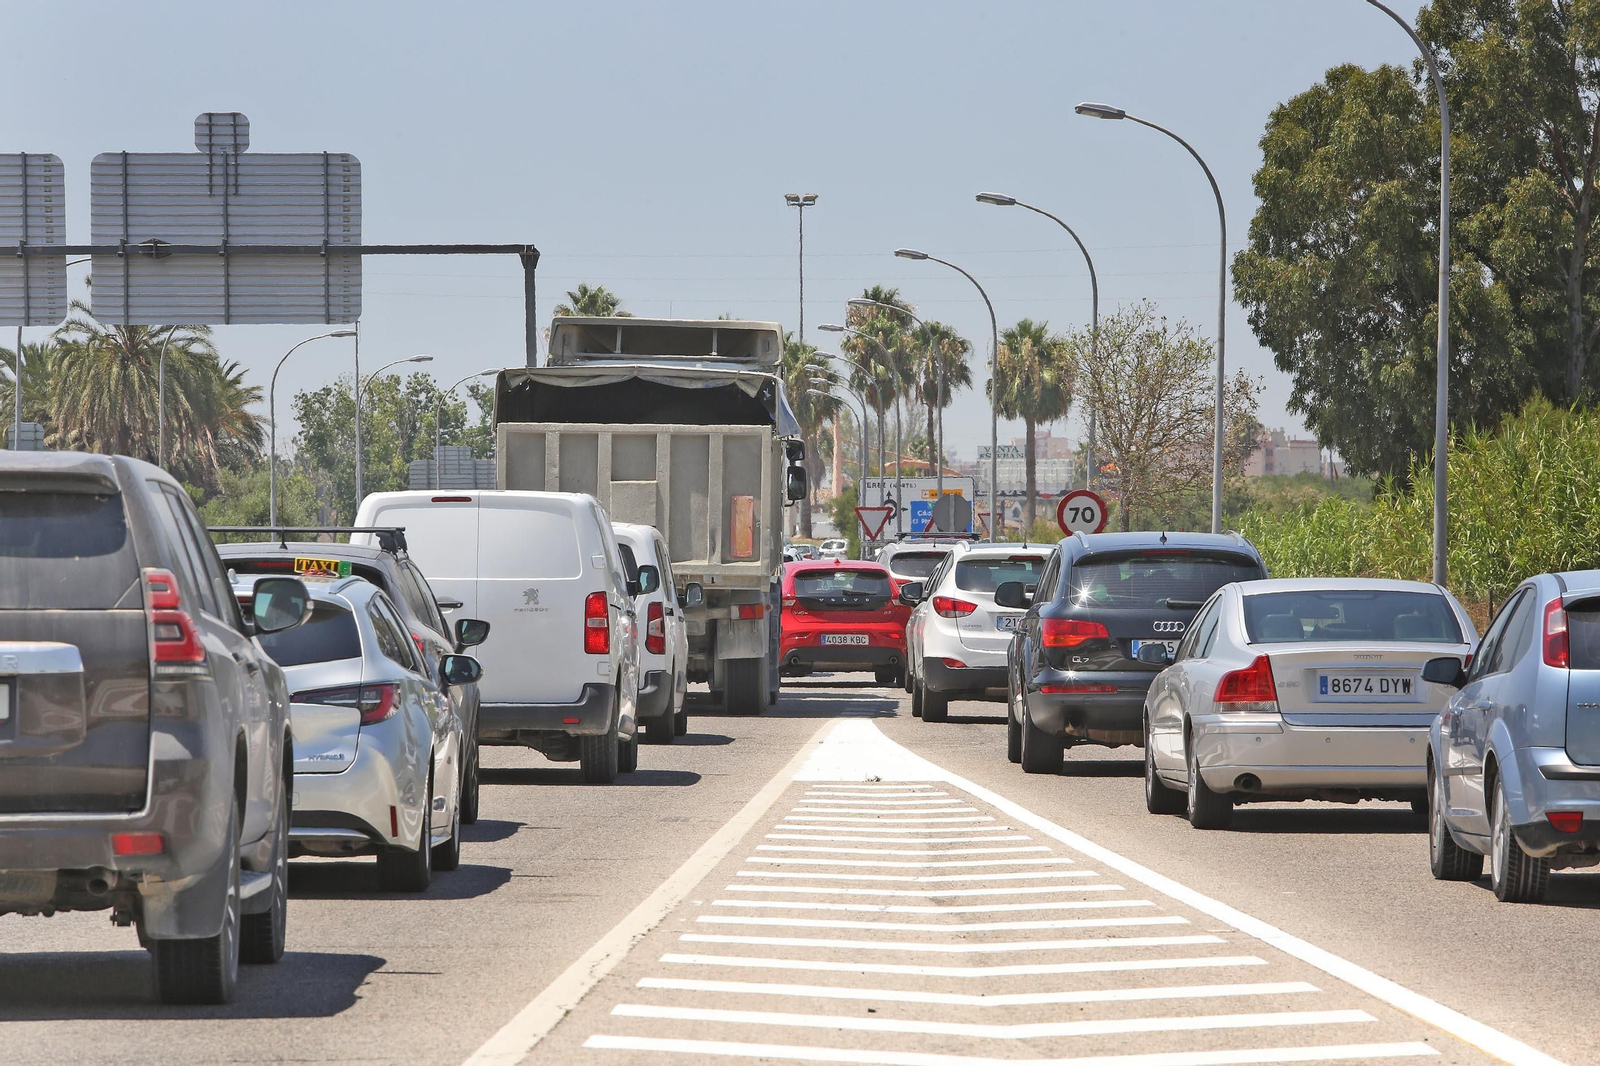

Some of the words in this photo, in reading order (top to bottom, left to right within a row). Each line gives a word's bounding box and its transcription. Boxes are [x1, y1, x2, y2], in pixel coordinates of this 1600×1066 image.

[1069, 506, 1095, 524] 70
[298, 559, 336, 571] TAXI
[1005, 617, 1018, 628] 21
[826, 635, 848, 644] 4038
[850, 635, 867, 644] KBC
[1071, 655, 1090, 664] Q7
[1331, 678, 1374, 693] 8674
[1379, 678, 1411, 693] DYW
